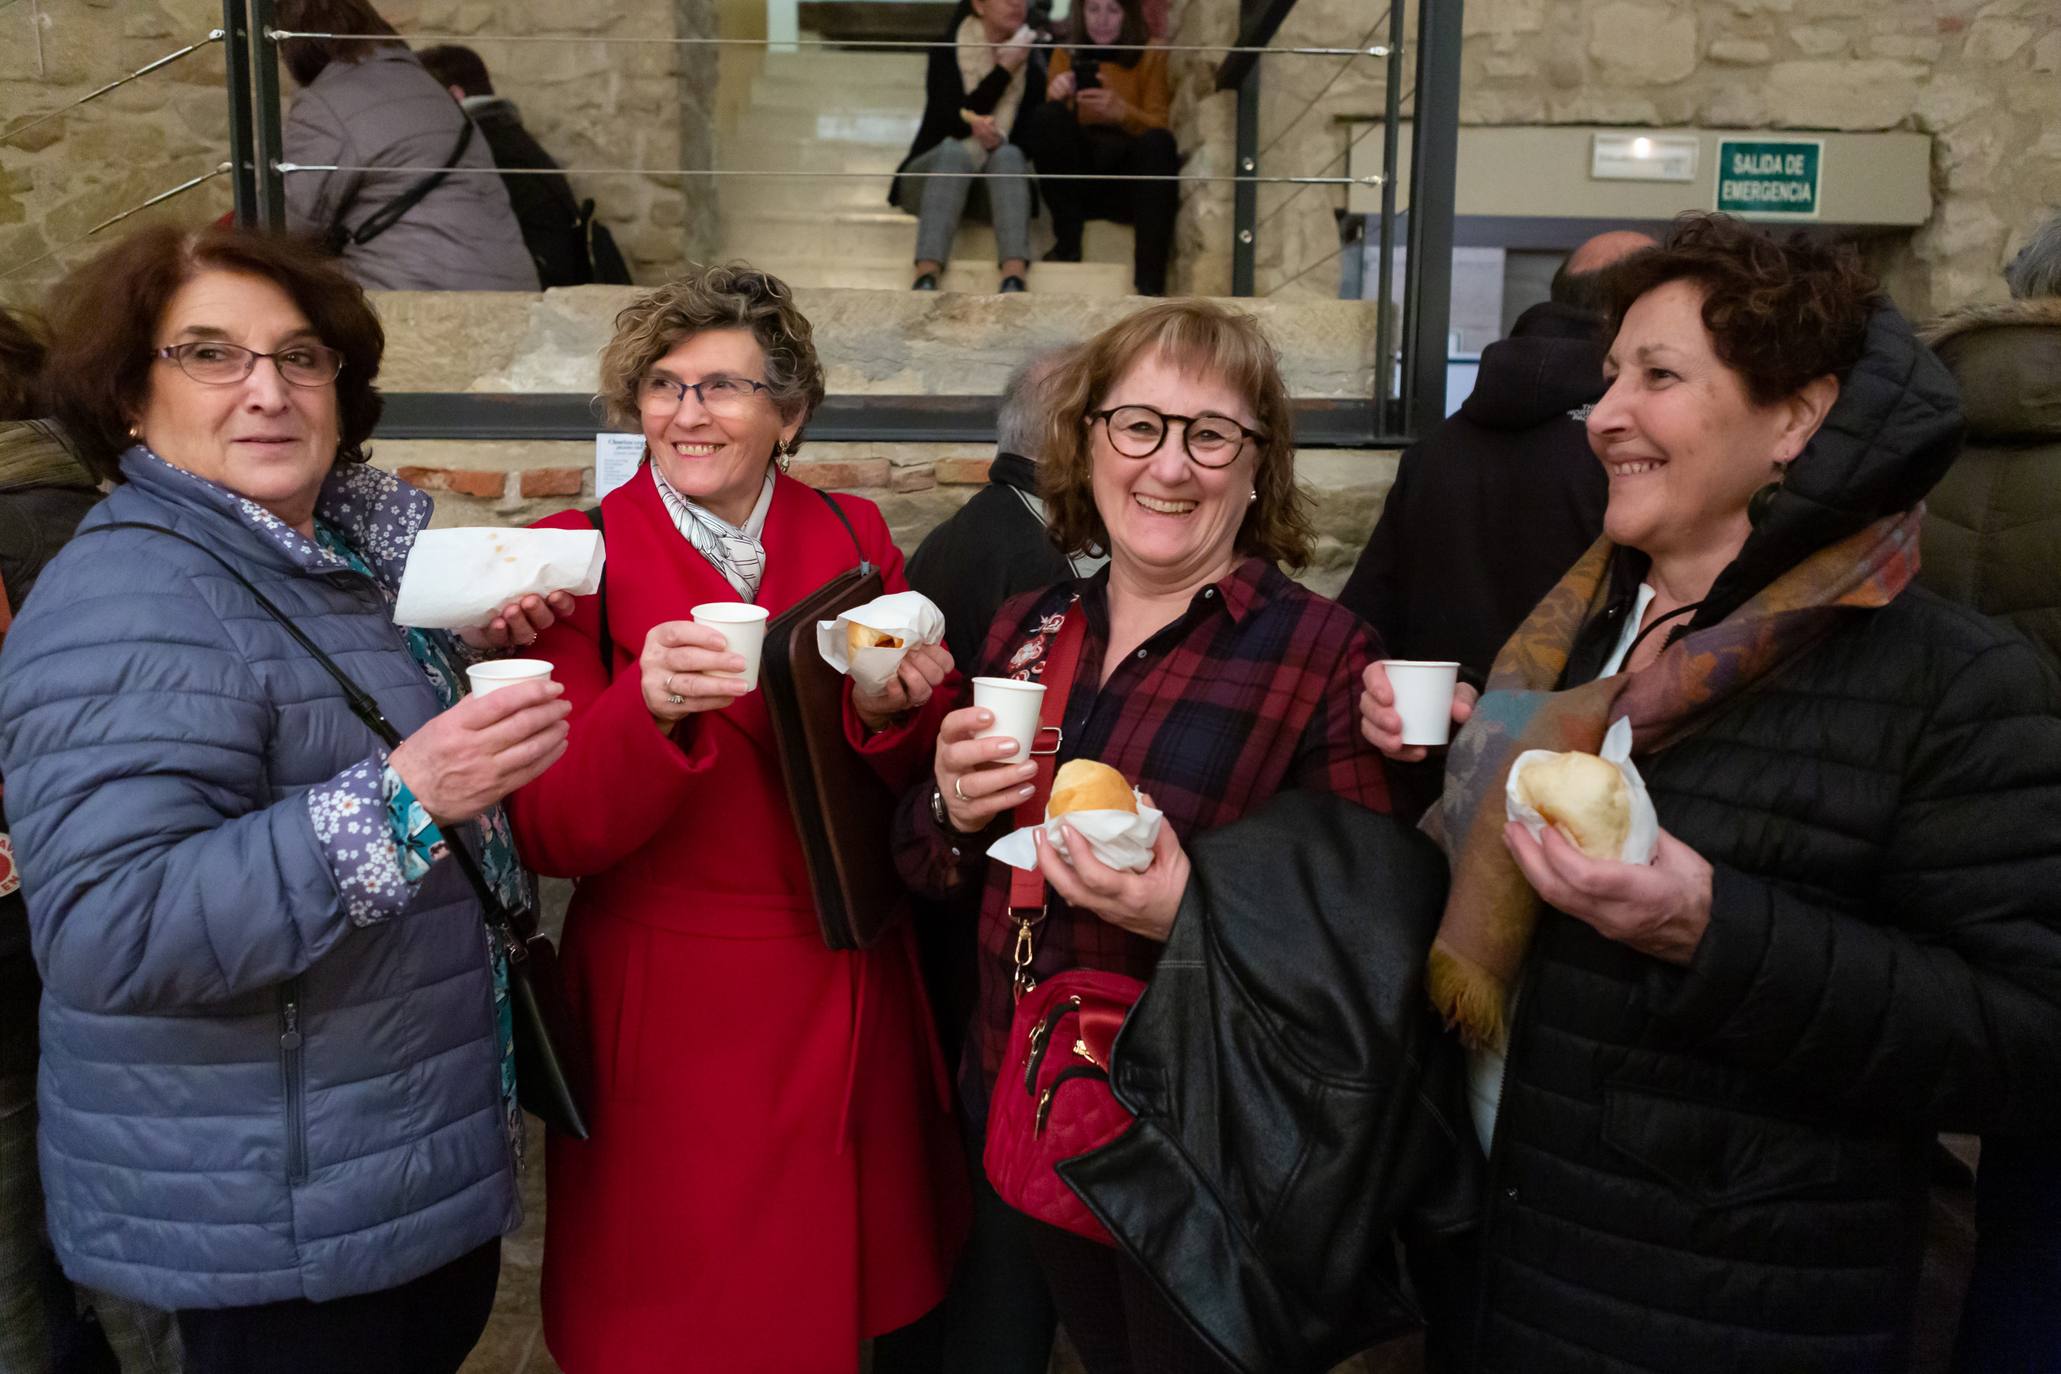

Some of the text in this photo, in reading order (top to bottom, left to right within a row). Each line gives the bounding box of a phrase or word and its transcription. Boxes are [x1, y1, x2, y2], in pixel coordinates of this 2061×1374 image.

[1733, 153, 1805, 175] SALIDA DE
[1723, 180, 1812, 202] EMERGENCIA
